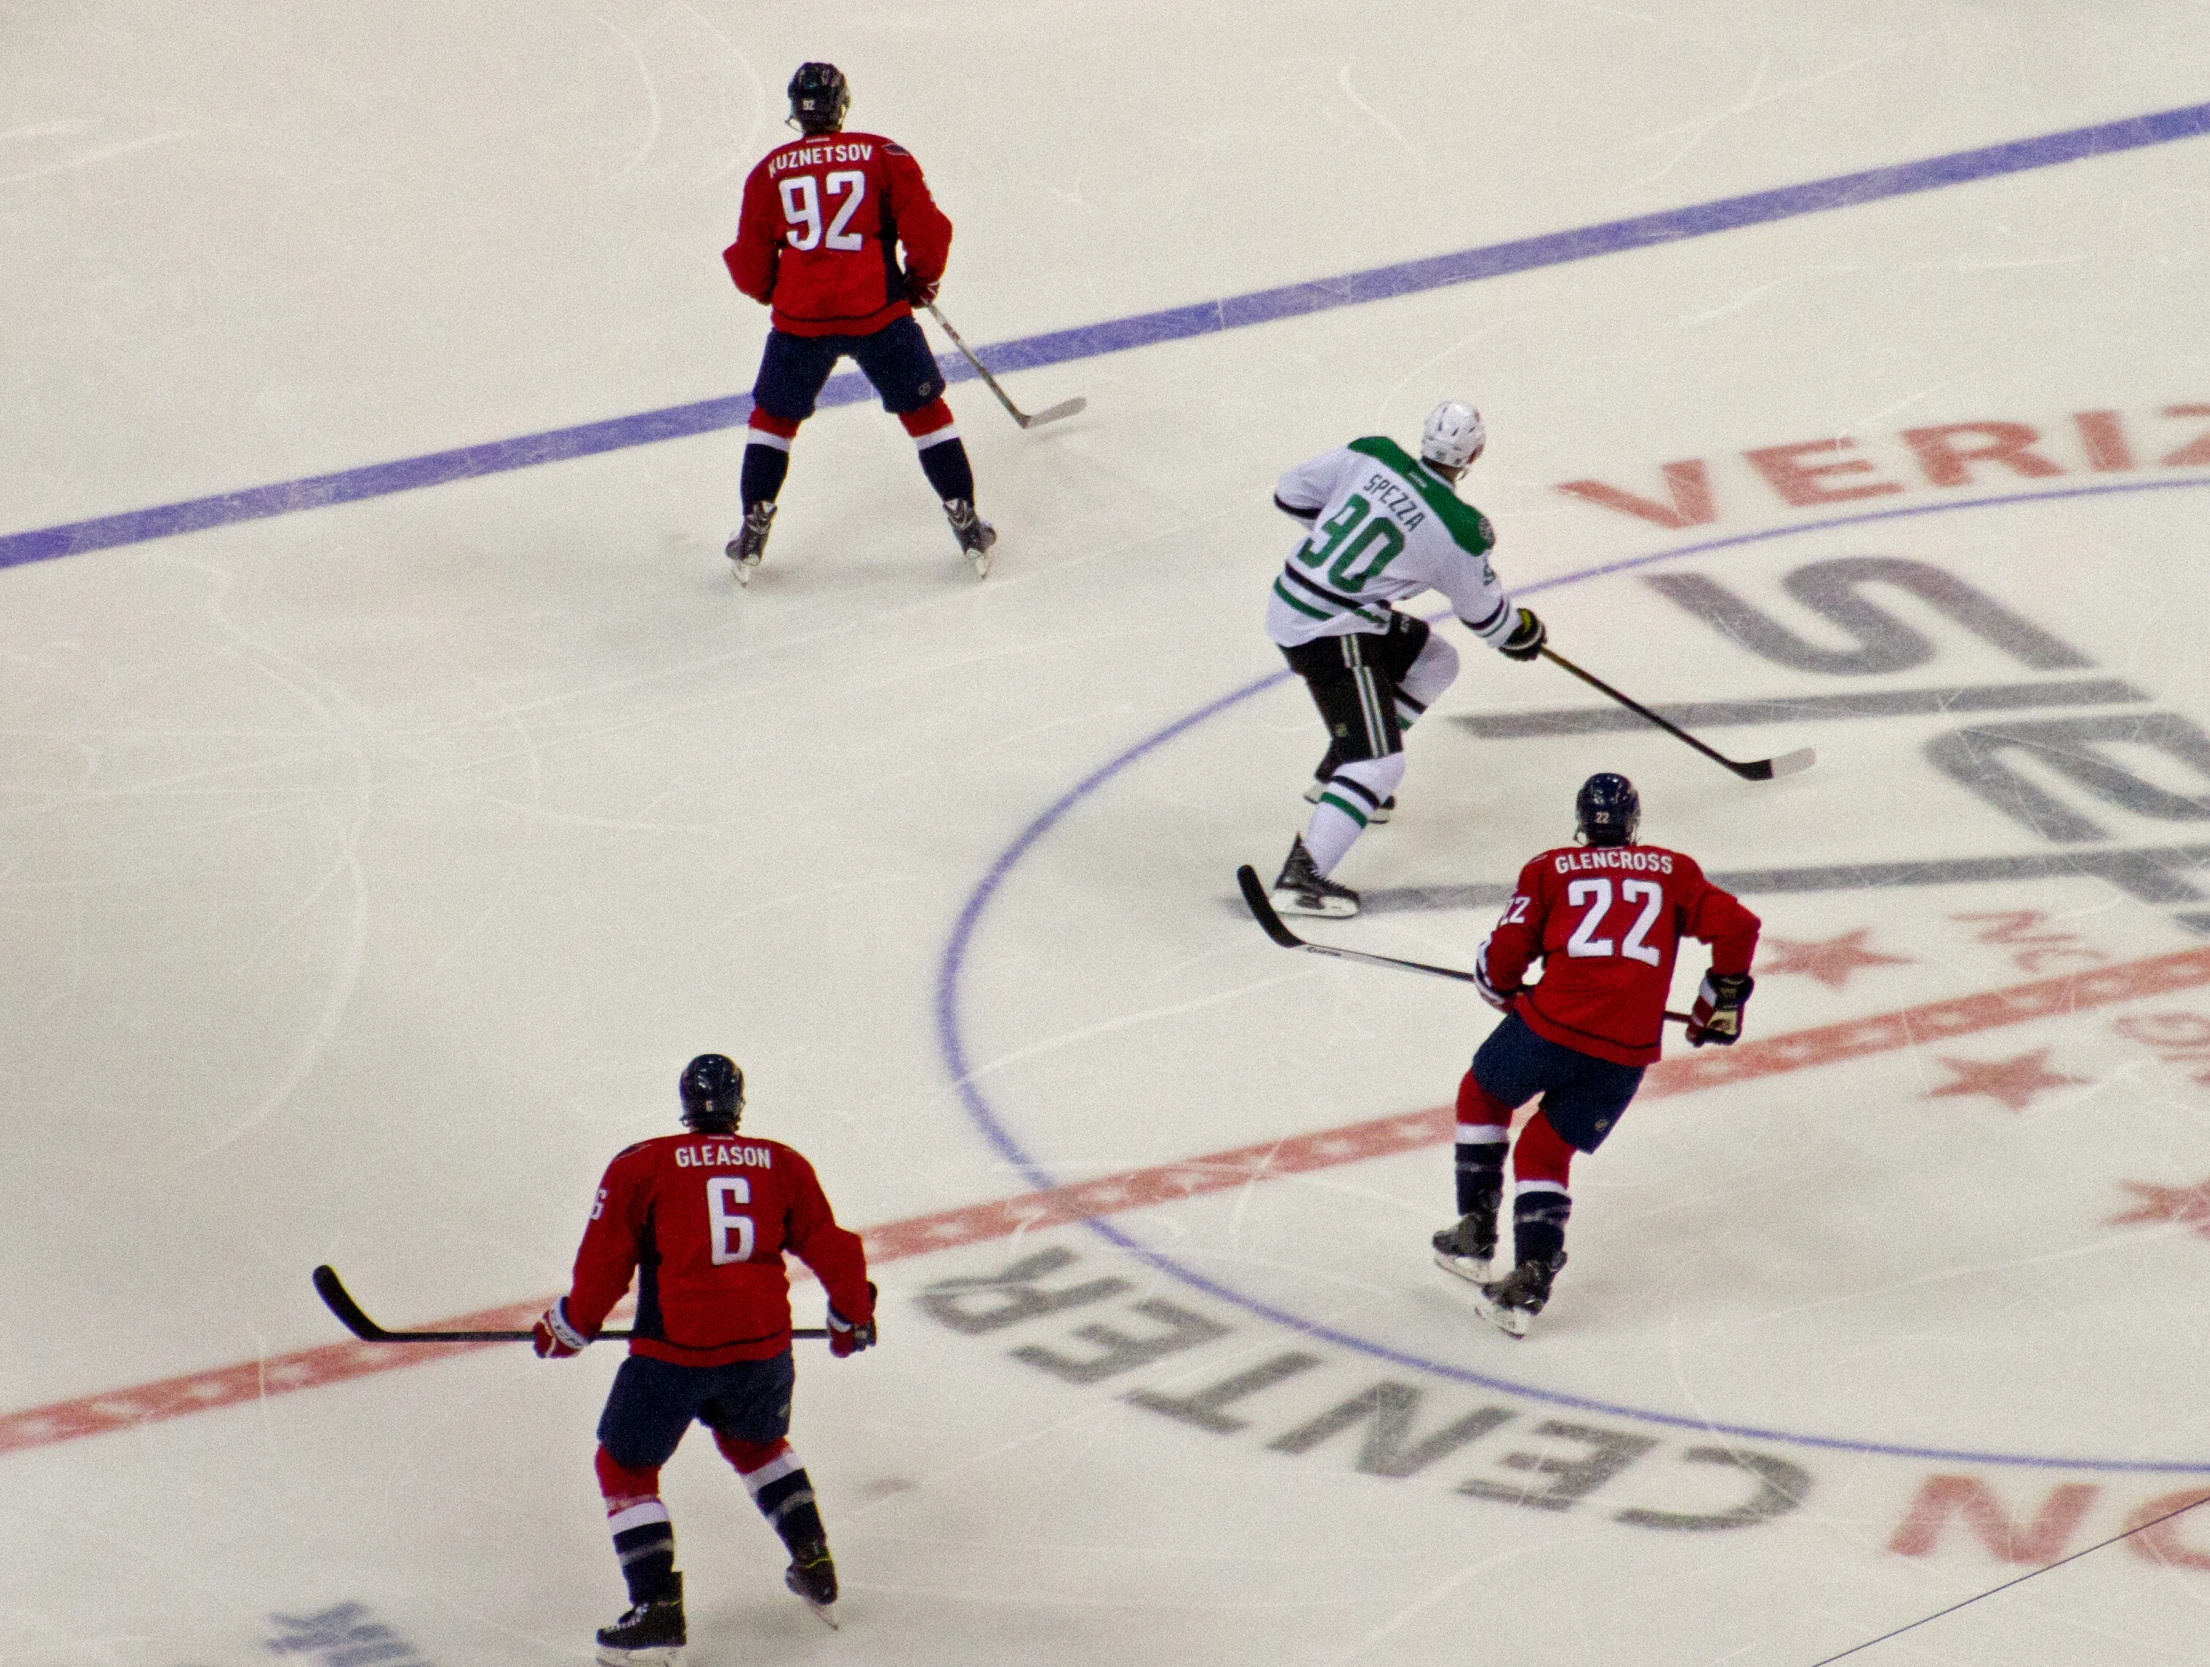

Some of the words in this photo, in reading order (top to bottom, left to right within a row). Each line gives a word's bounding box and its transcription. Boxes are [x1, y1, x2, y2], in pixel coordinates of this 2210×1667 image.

[769, 144, 873, 178] KUZNETSOV
[778, 170, 866, 251] 92
[1363, 474, 1427, 532] SPEZZA
[1296, 493, 1405, 594] 90
[1595, 812, 1609, 824] 22
[1555, 851, 1673, 874] GLENCROSS
[1567, 877, 1663, 967] 22
[675, 1145, 772, 1169] GLEASON
[706, 1175, 756, 1266] 6
[912, 1247, 1815, 1532] CENTER
